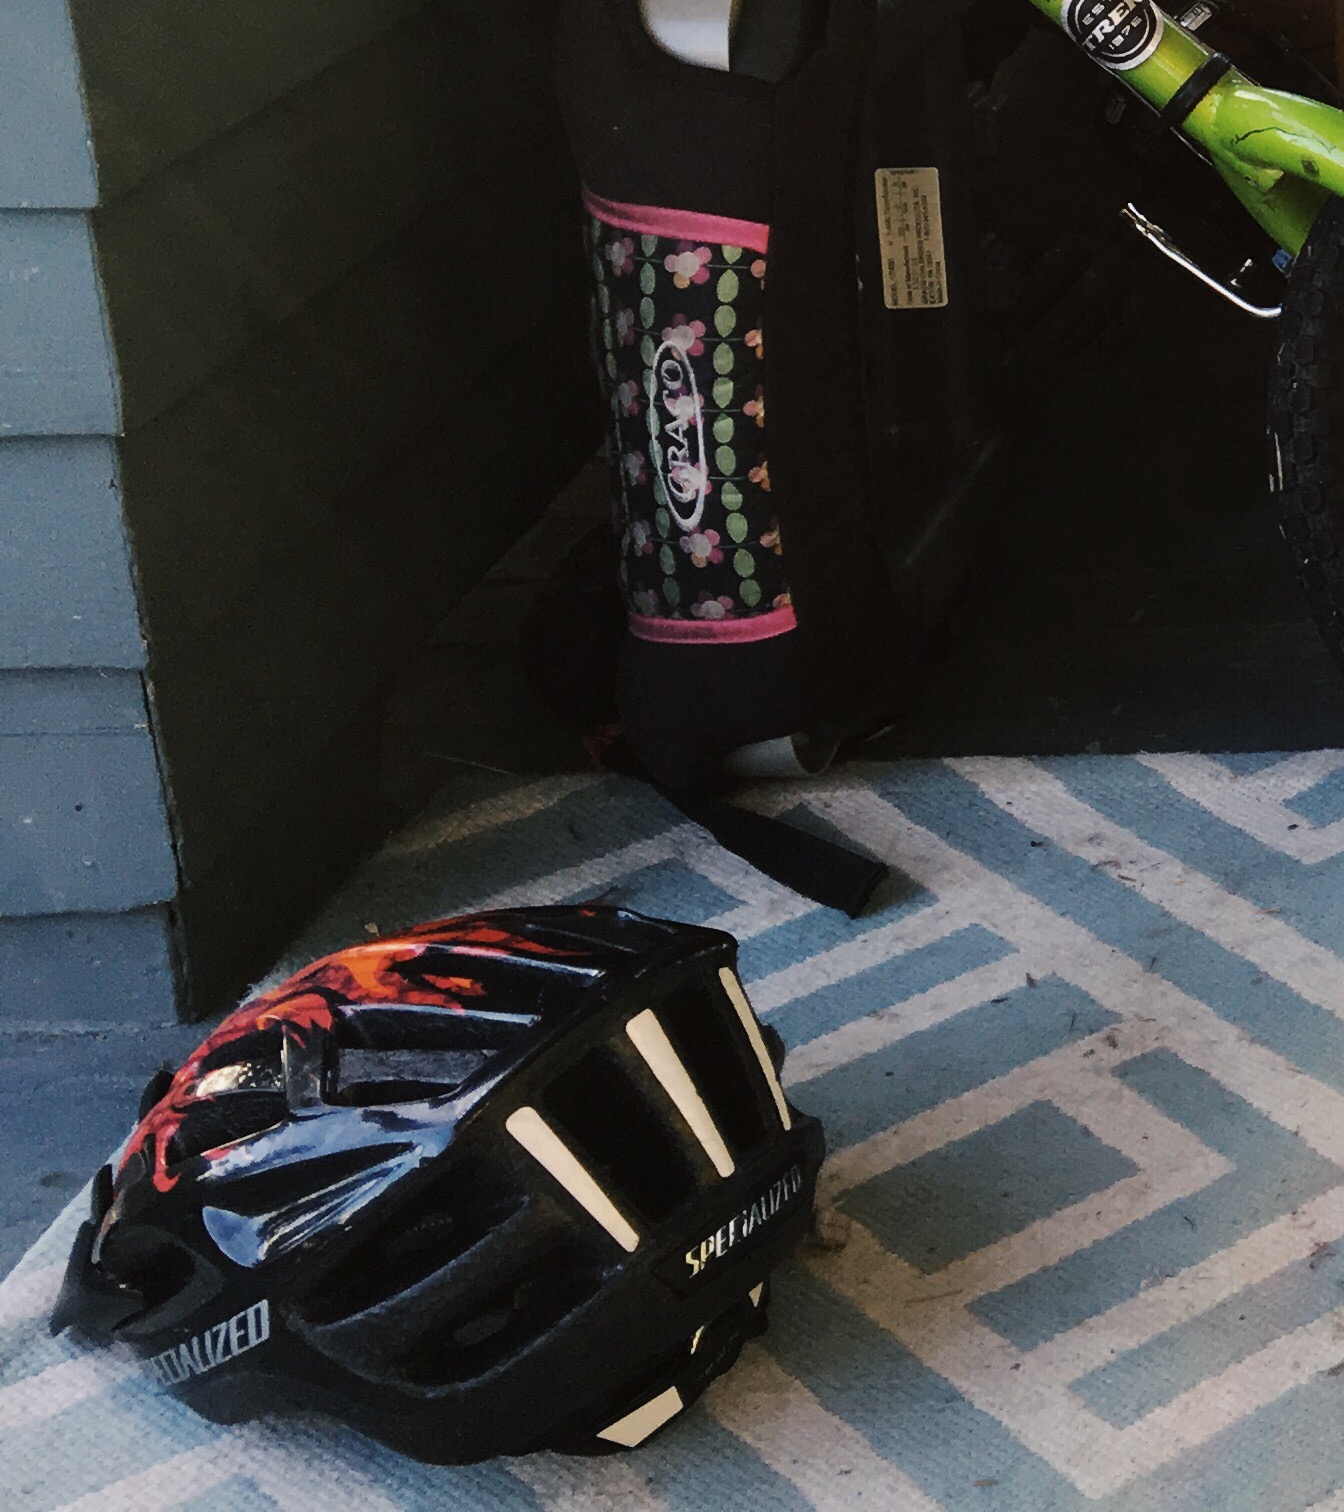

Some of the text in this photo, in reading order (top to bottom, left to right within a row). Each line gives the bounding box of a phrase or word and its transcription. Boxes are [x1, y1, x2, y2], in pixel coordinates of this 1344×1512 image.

[659, 358, 697, 504] GRACO
[684, 1164, 804, 1280] SPECIALIZED
[145, 1298, 271, 1387] ECIALIZED
